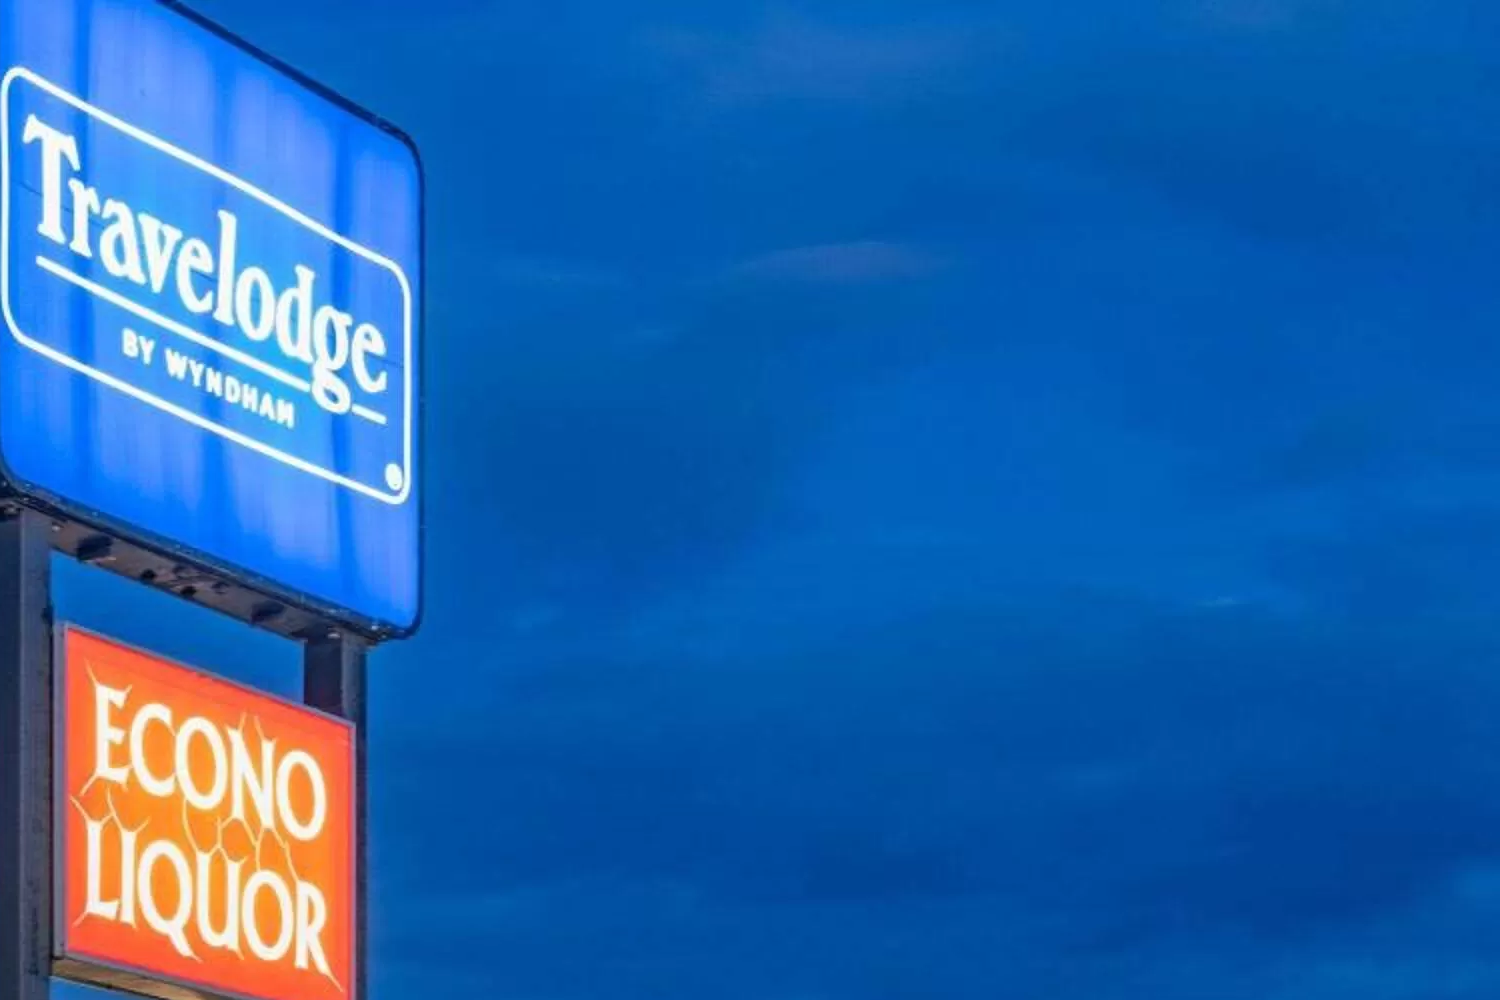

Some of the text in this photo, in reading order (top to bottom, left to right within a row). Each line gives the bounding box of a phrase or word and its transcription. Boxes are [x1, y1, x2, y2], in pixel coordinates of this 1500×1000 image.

[22, 113, 387, 415] Travelodge
[122, 327, 295, 428] BY WYNDHAM
[85, 672, 327, 841] ECONO
[78, 812, 341, 990] LIQUOR
